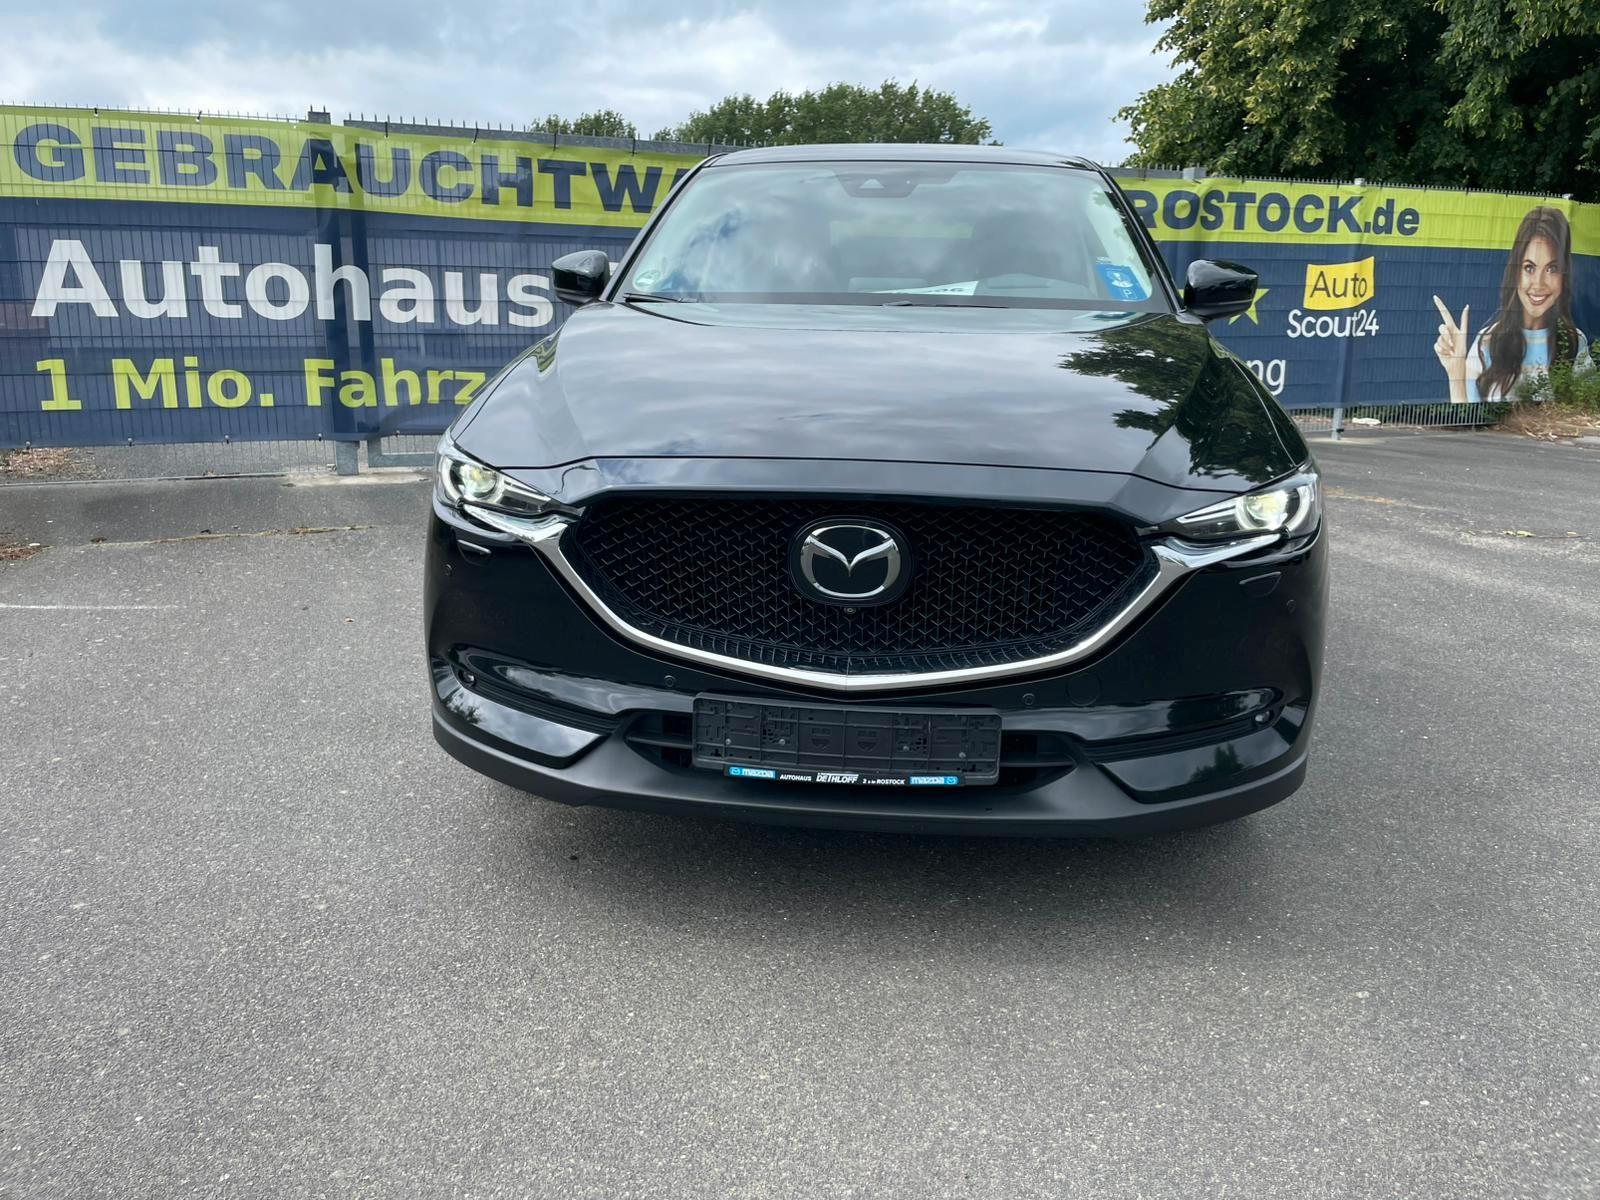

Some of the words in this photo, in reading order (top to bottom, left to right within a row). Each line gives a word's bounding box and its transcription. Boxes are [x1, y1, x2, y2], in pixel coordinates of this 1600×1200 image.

[31, 239, 553, 328] Autohaus
[1309, 270, 1368, 298] Auto
[1286, 308, 1380, 338] Scout24
[36, 358, 82, 411] 1
[112, 356, 274, 410] Mio.
[304, 357, 486, 409] Fahrz
[780, 773, 812, 781] AUTOHAUS
